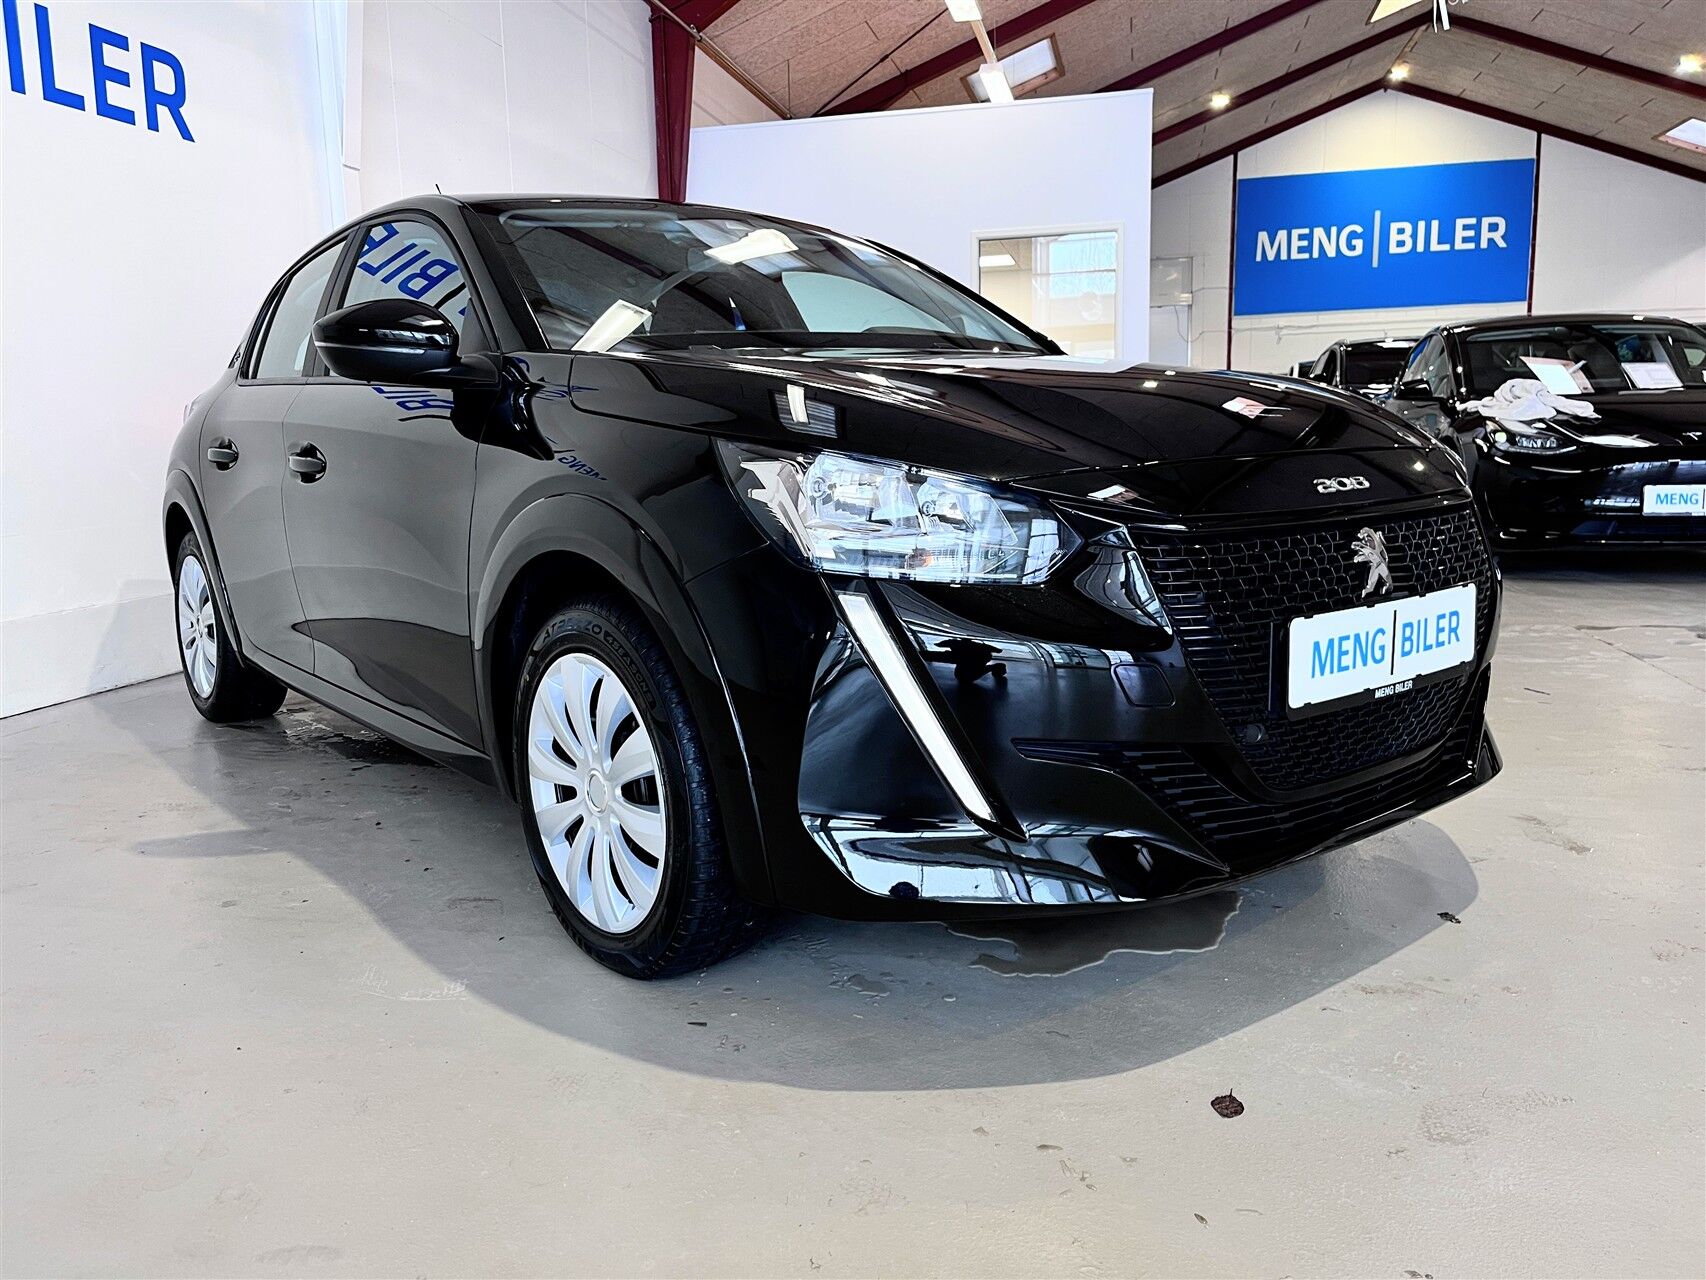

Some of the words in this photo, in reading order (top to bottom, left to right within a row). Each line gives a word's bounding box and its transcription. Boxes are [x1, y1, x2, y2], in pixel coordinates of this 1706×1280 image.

[1255, 224, 1364, 262] MENG
[1388, 216, 1508, 255] BILER
[1313, 476, 1370, 493] 208
[1655, 492, 1699, 505] MENG
[1311, 627, 1385, 679] MENG
[1400, 610, 1460, 657] BILER
[1374, 685, 1394, 698] MENG
[1395, 680, 1412, 692] BILER
